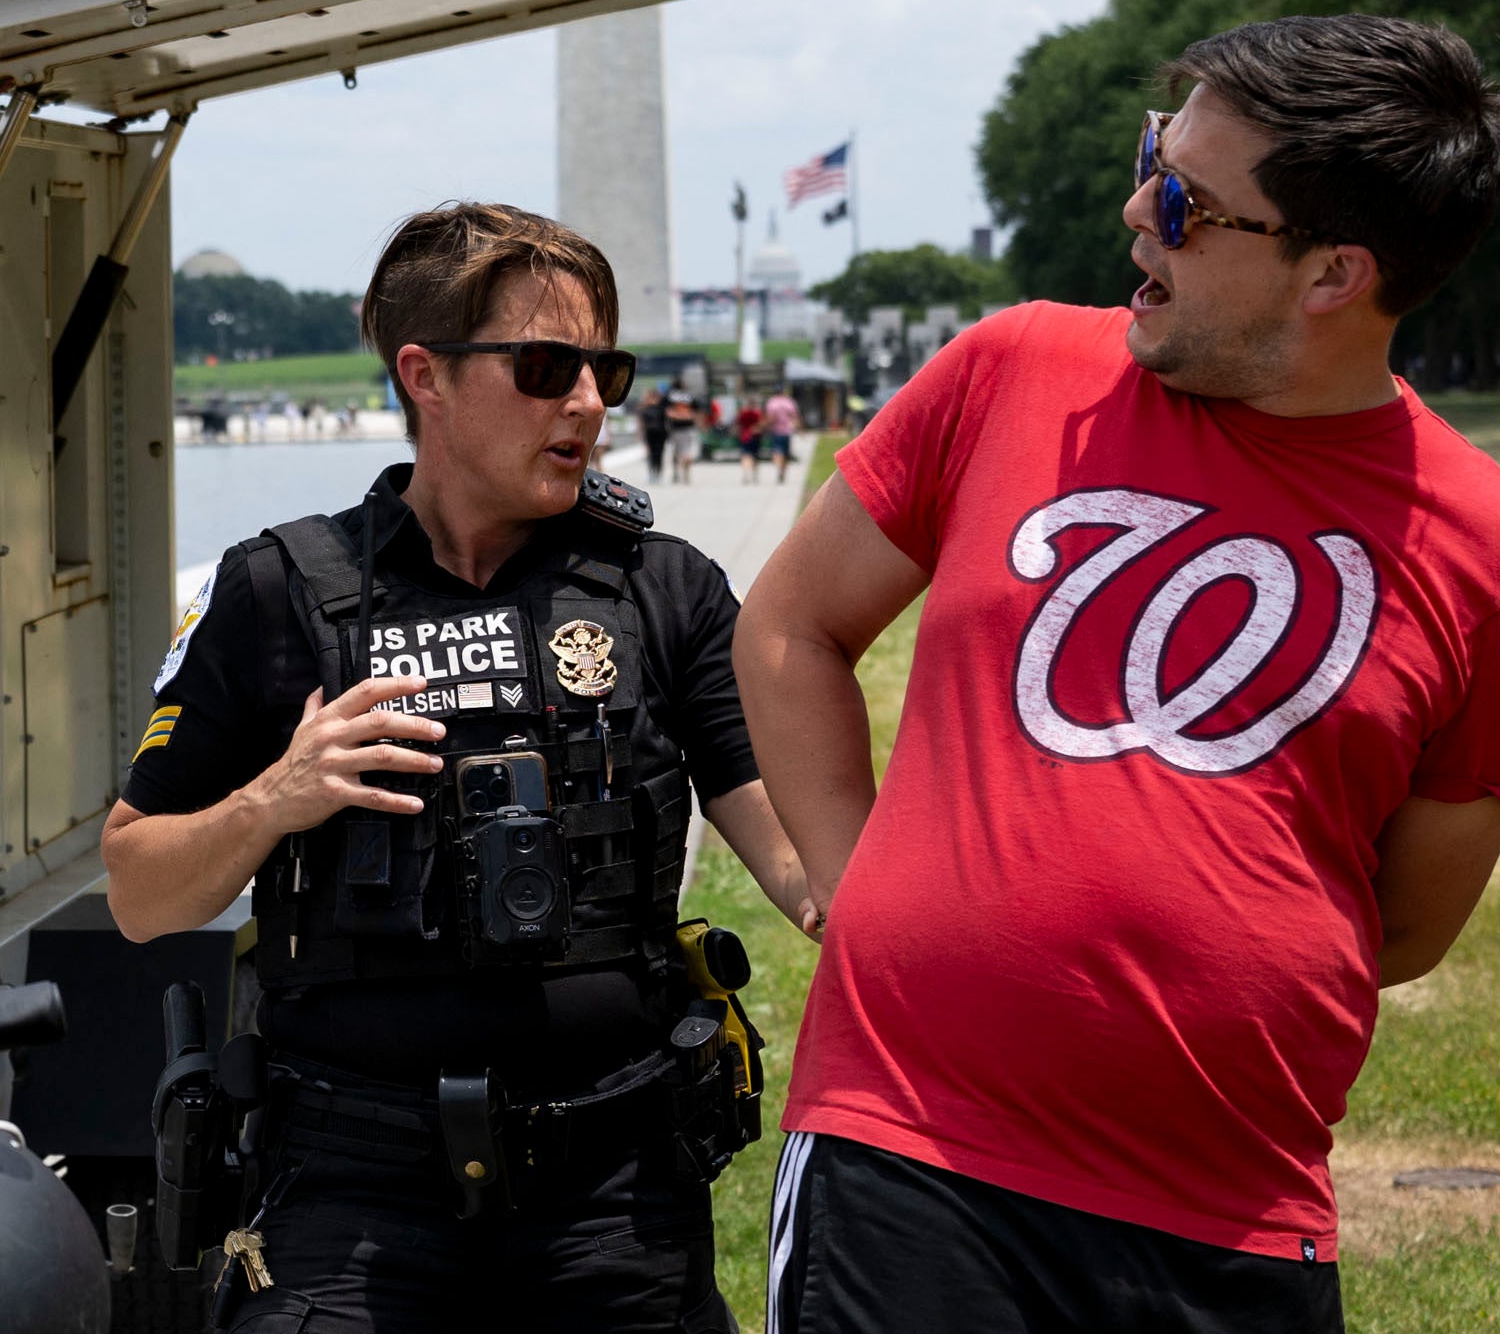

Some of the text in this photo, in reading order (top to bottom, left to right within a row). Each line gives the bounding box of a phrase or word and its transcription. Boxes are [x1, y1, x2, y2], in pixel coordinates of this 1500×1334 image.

[416, 612, 512, 647] PARK
[1008, 486, 1382, 778] W
[370, 640, 519, 680] POLICE
